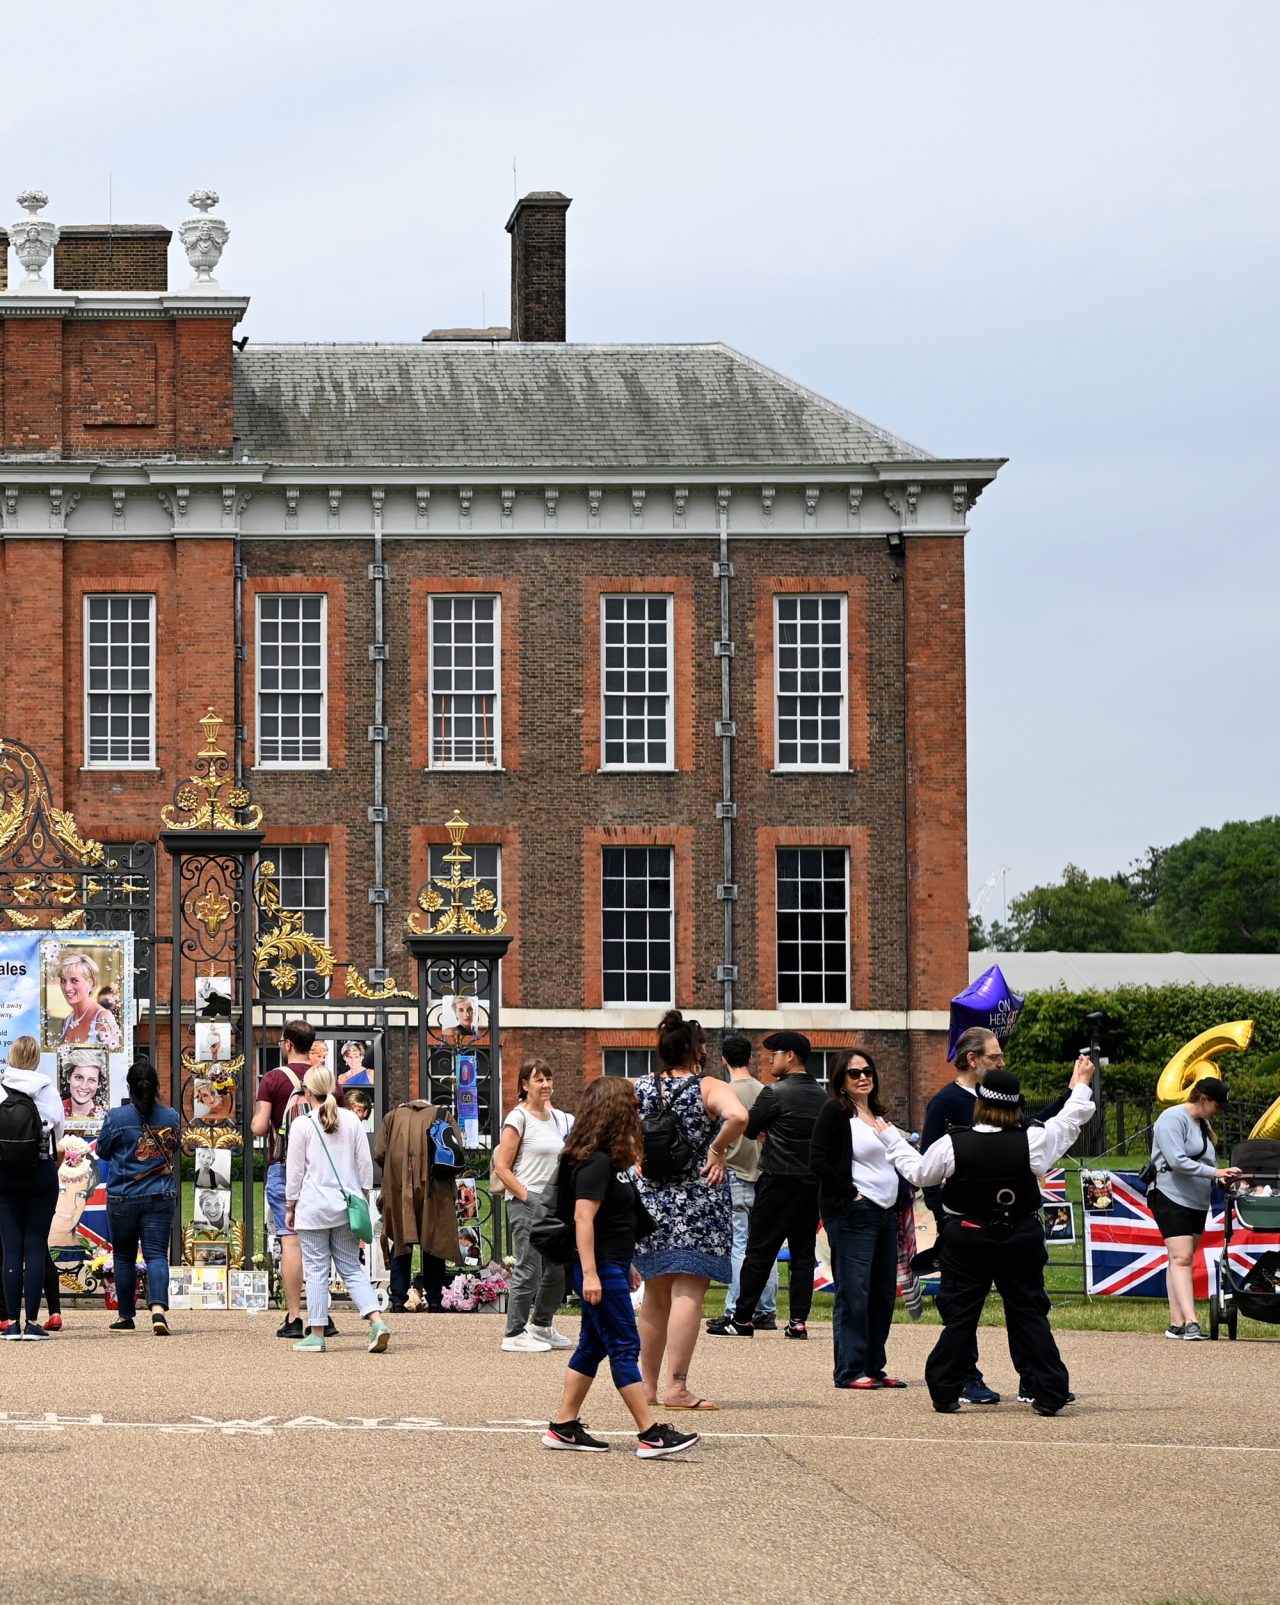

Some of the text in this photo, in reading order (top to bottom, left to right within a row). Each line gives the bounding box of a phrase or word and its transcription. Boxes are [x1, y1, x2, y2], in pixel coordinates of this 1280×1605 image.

[998, 998, 1010, 1013] ON
[990, 1013, 1006, 1026] HER
[191, 1415, 445, 1427] WAYS
